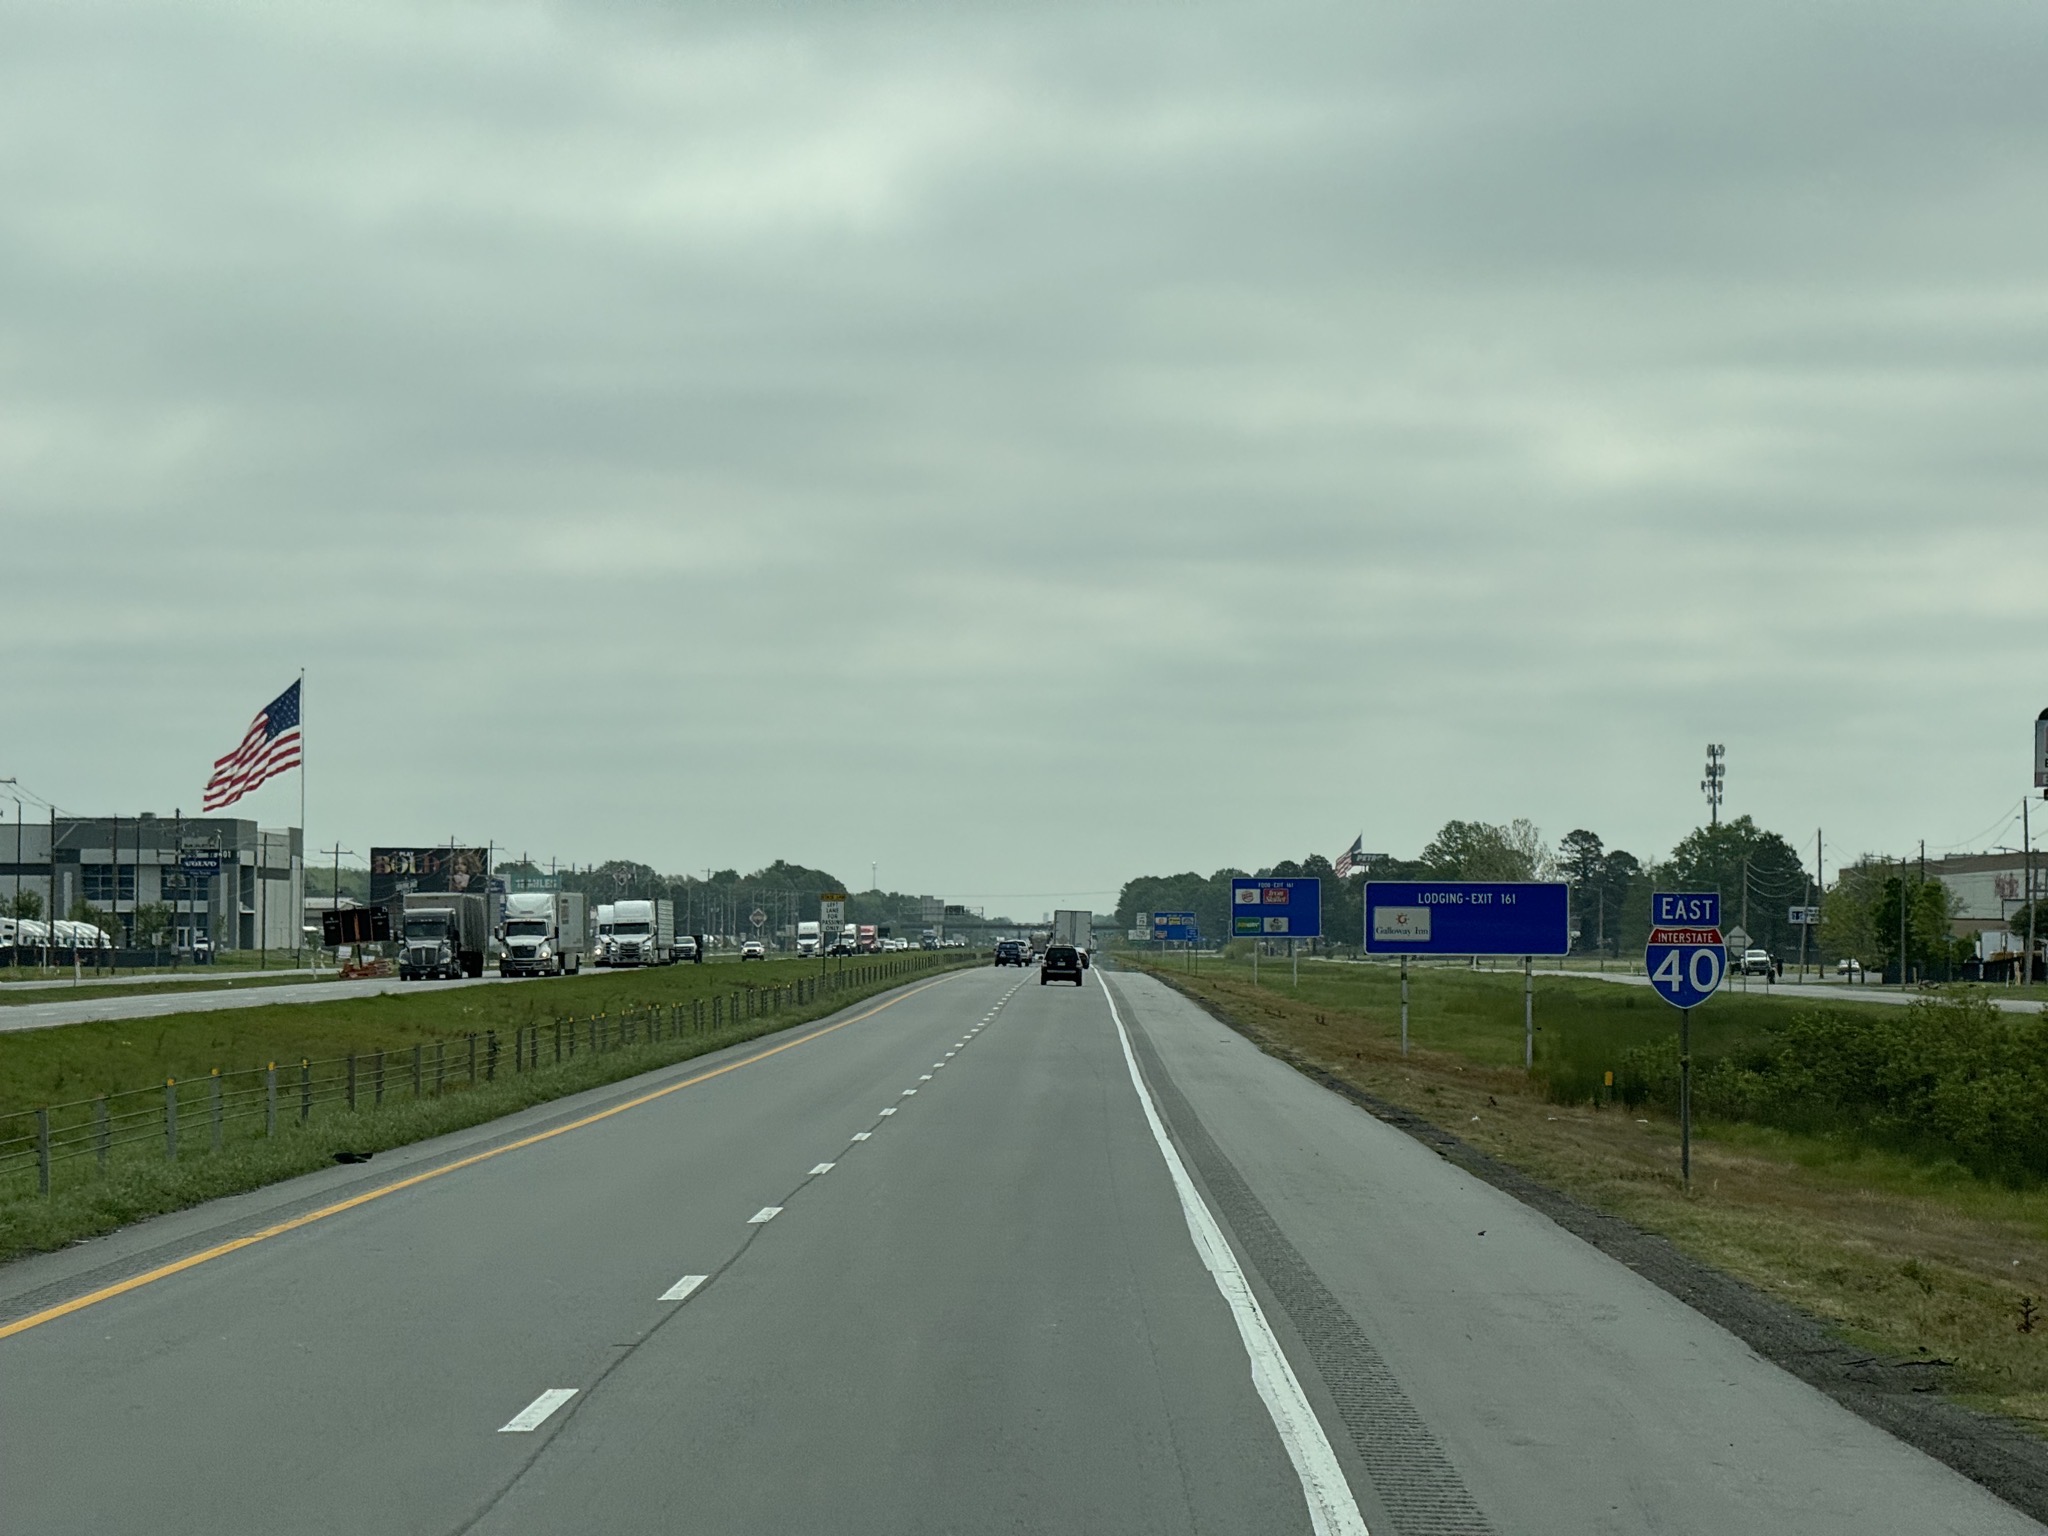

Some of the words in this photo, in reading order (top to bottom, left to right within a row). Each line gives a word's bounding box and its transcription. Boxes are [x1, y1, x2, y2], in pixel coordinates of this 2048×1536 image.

[374, 854, 441, 874] BOLD
[1501, 893, 1516, 904] 161
[1662, 897, 1713, 920] EAST
[1376, 926, 1411, 936] Galloway
[1415, 926, 1428, 935] Inn
[1658, 933, 1713, 943] INTERSTATE
[1652, 948, 1720, 993] 40
